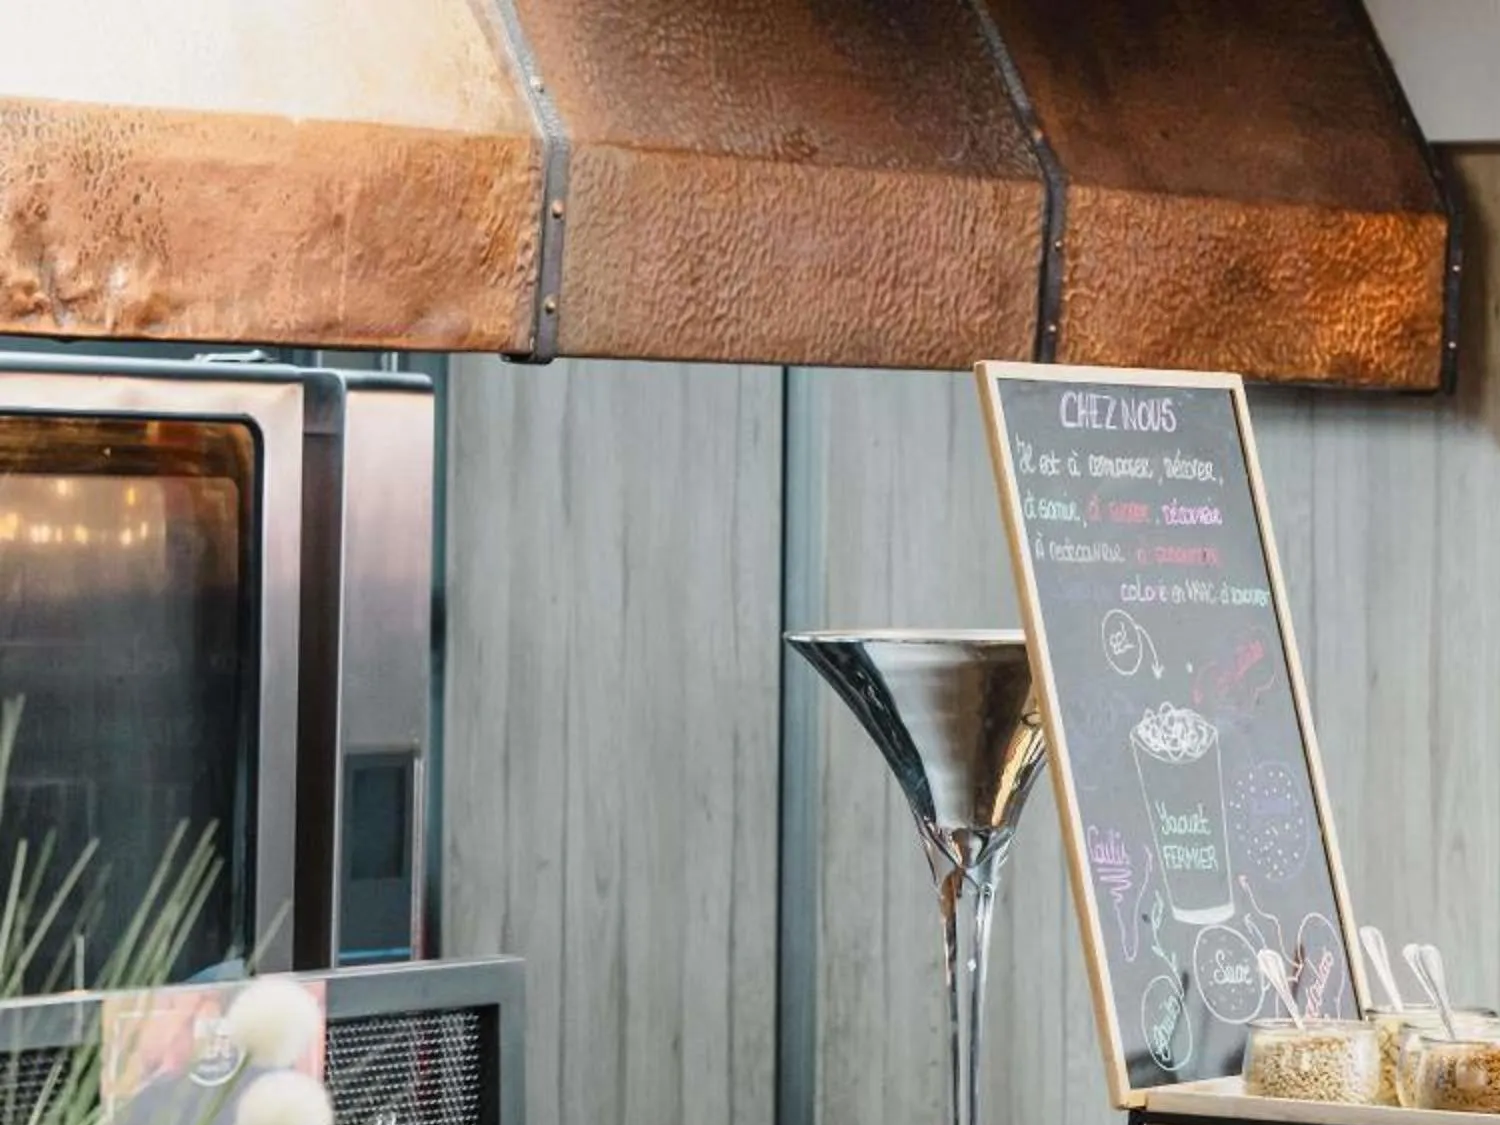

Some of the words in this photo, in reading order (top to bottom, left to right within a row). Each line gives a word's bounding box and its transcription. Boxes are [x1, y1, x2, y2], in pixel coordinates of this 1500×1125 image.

[1061, 390, 1118, 429] CHEZ
[1120, 397, 1177, 433] NOUS
[1155, 800, 1213, 836] Yaourt
